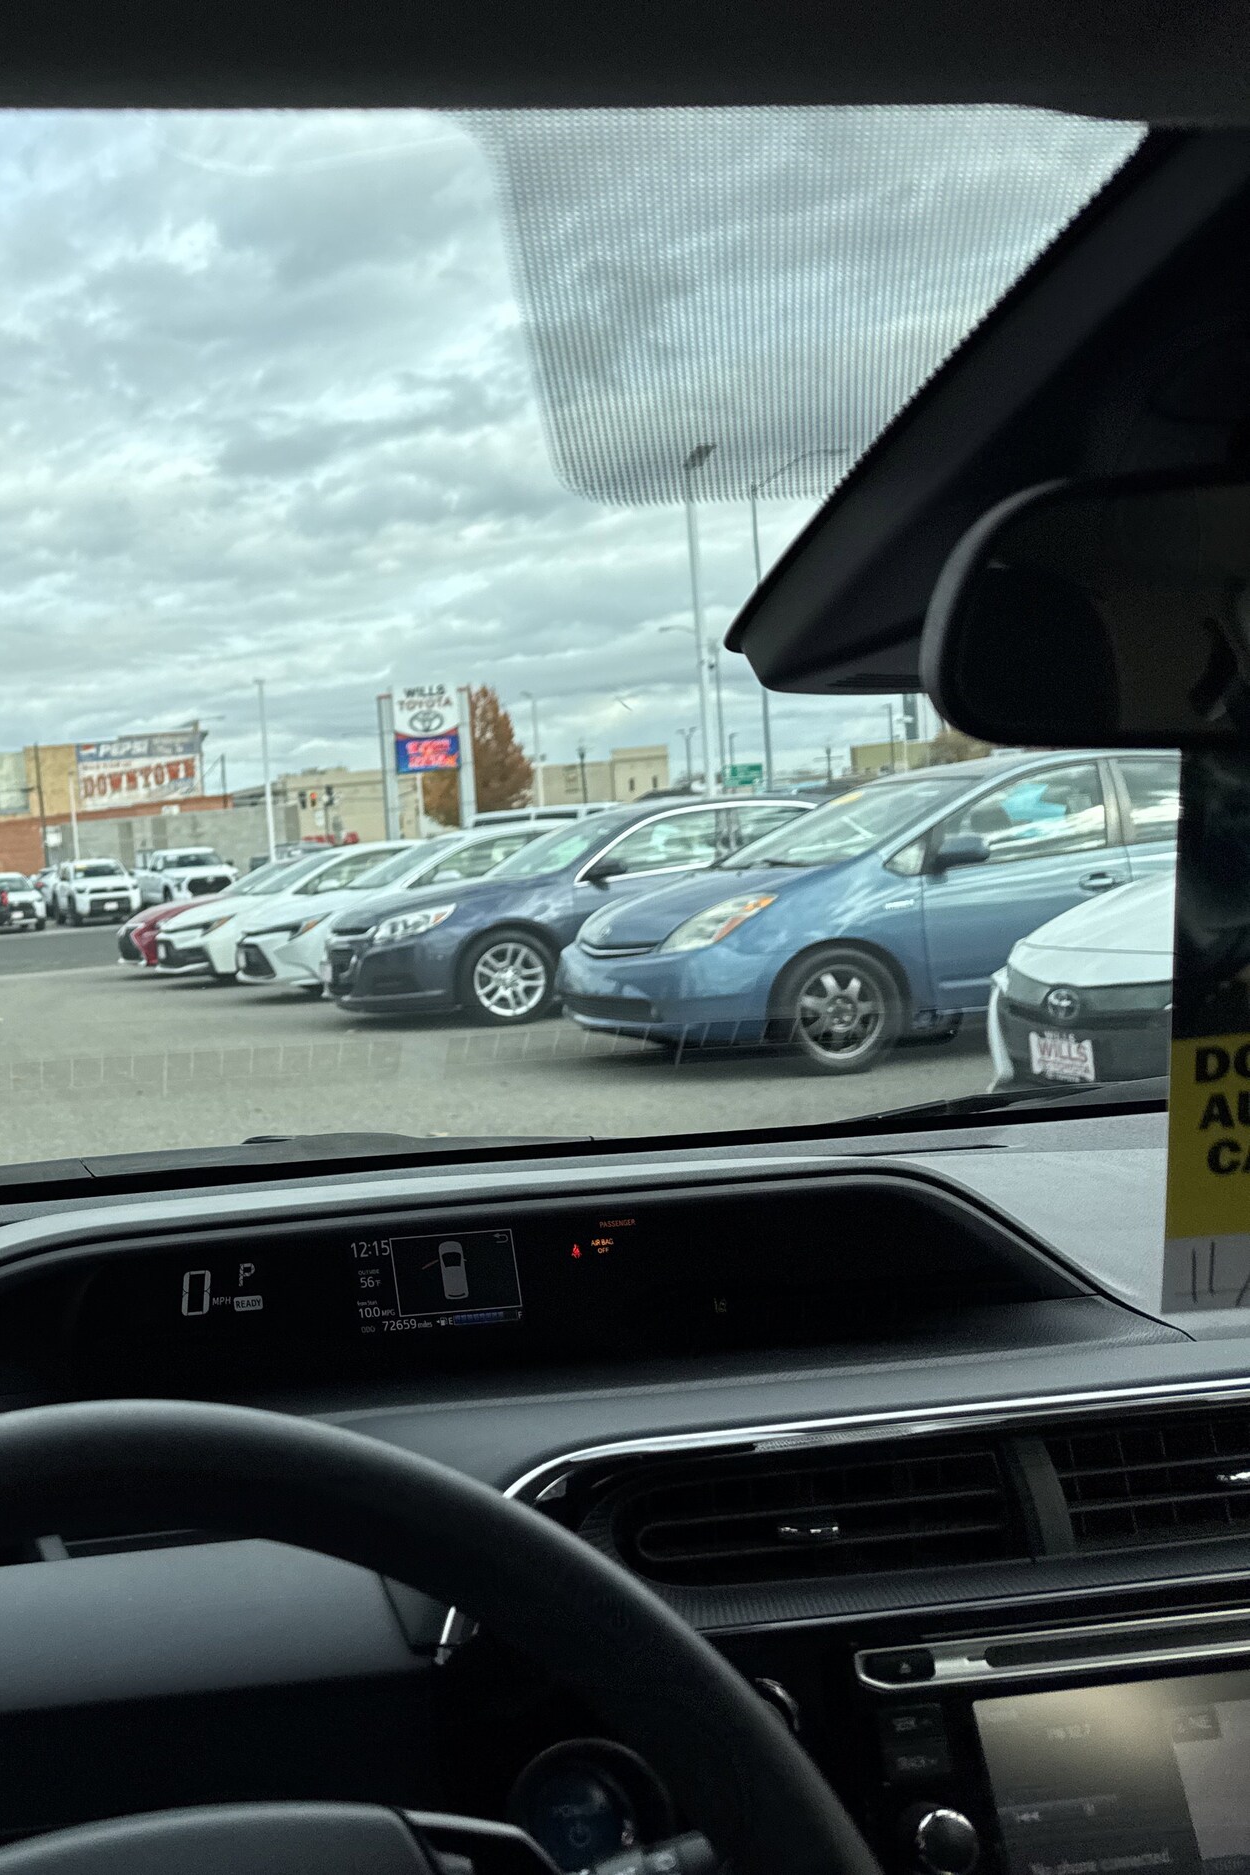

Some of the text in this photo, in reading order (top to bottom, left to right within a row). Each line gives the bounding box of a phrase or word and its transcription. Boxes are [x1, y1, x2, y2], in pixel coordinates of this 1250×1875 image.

[404, 684, 445, 698] WILLS
[398, 697, 452, 711] TOYOTA
[99, 739, 148, 758] PEPSI
[83, 757, 196, 798] DOWNTOWN
[1038, 1039, 1088, 1062] WILLS
[599, 1218, 636, 1228] PASSENGER
[350, 1240, 390, 1258] 12:15
[238, 1262, 256, 1287] P
[181, 1270, 232, 1316] 0 MPH
[235, 1299, 262, 1309] READY
[381, 1308, 396, 1317] MPG
[382, 1318, 417, 1332] 72659
[417, 1320, 433, 1329] miles
